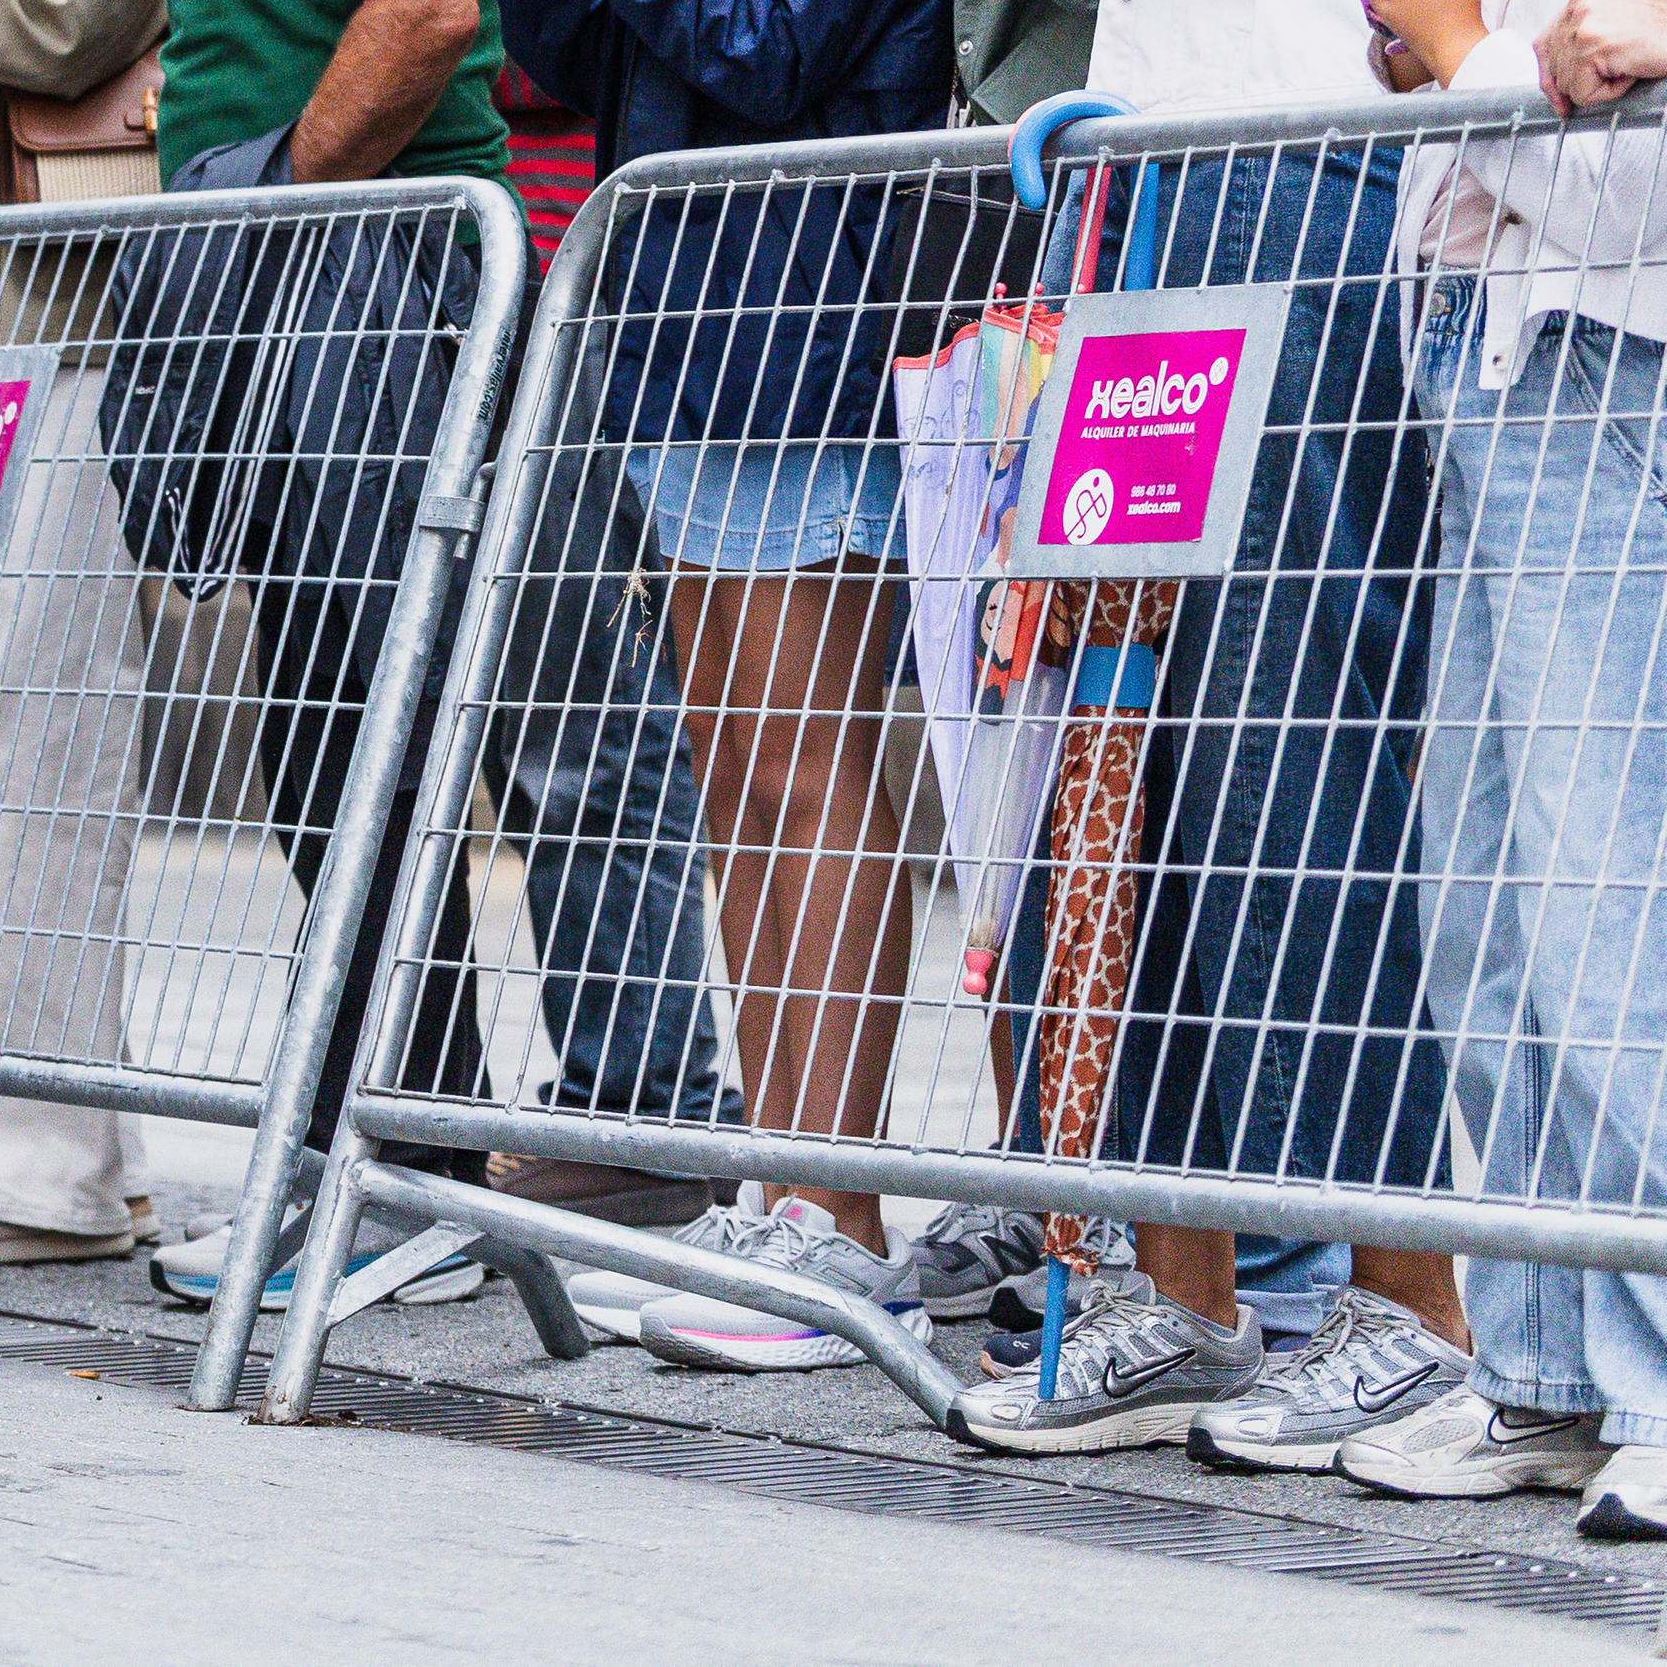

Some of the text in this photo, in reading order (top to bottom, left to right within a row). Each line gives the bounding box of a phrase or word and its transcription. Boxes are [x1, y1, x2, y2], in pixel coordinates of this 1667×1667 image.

[1084, 360, 1208, 419] xealco
[1080, 421, 1196, 440] ALQUILER DE MAQUINARIA
